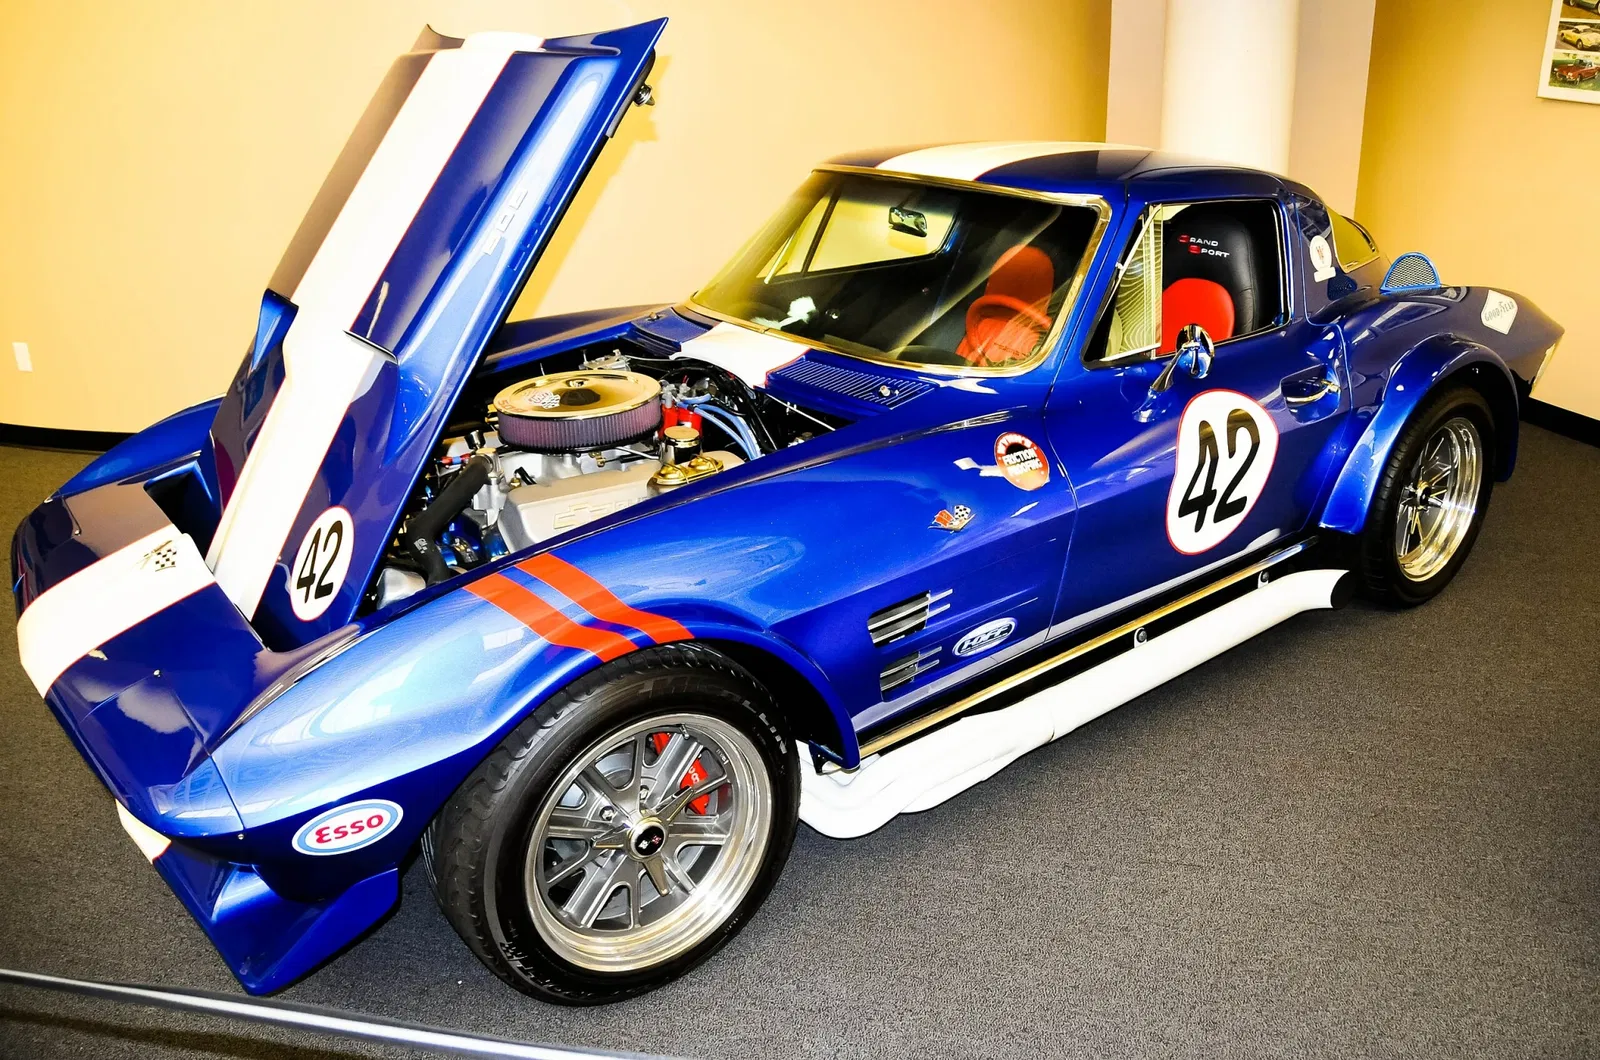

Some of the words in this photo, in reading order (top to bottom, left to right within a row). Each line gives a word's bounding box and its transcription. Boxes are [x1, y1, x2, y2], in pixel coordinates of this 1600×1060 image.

[1188, 245, 1230, 258] SPORT
[1002, 448, 1038, 465] FRICTION
[1178, 408, 1261, 533] 42
[296, 520, 344, 604] 42
